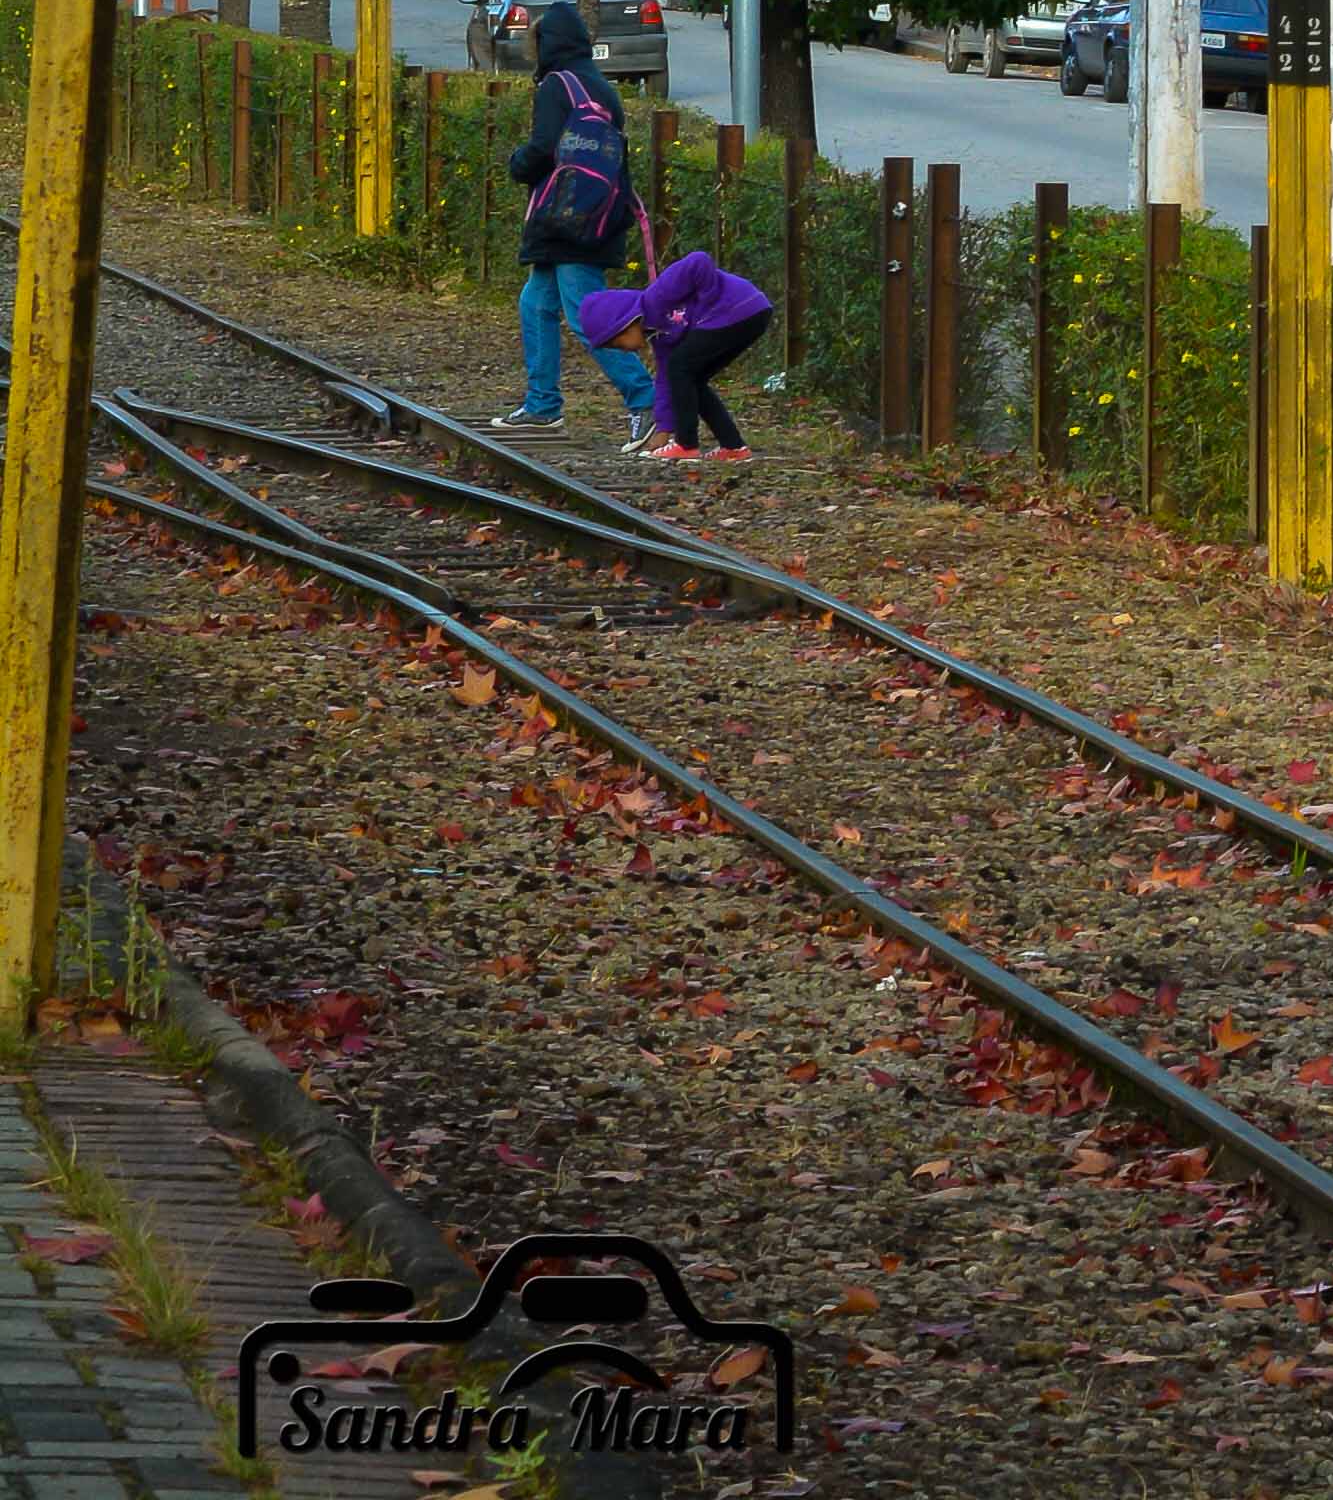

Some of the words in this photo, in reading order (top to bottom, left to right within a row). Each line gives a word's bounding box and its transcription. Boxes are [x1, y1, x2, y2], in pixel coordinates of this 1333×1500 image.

[1279, 15, 1291, 34] 4
[1307, 17, 1322, 36] 2
[1279, 53, 1293, 72] 2
[1307, 54, 1322, 72] 2
